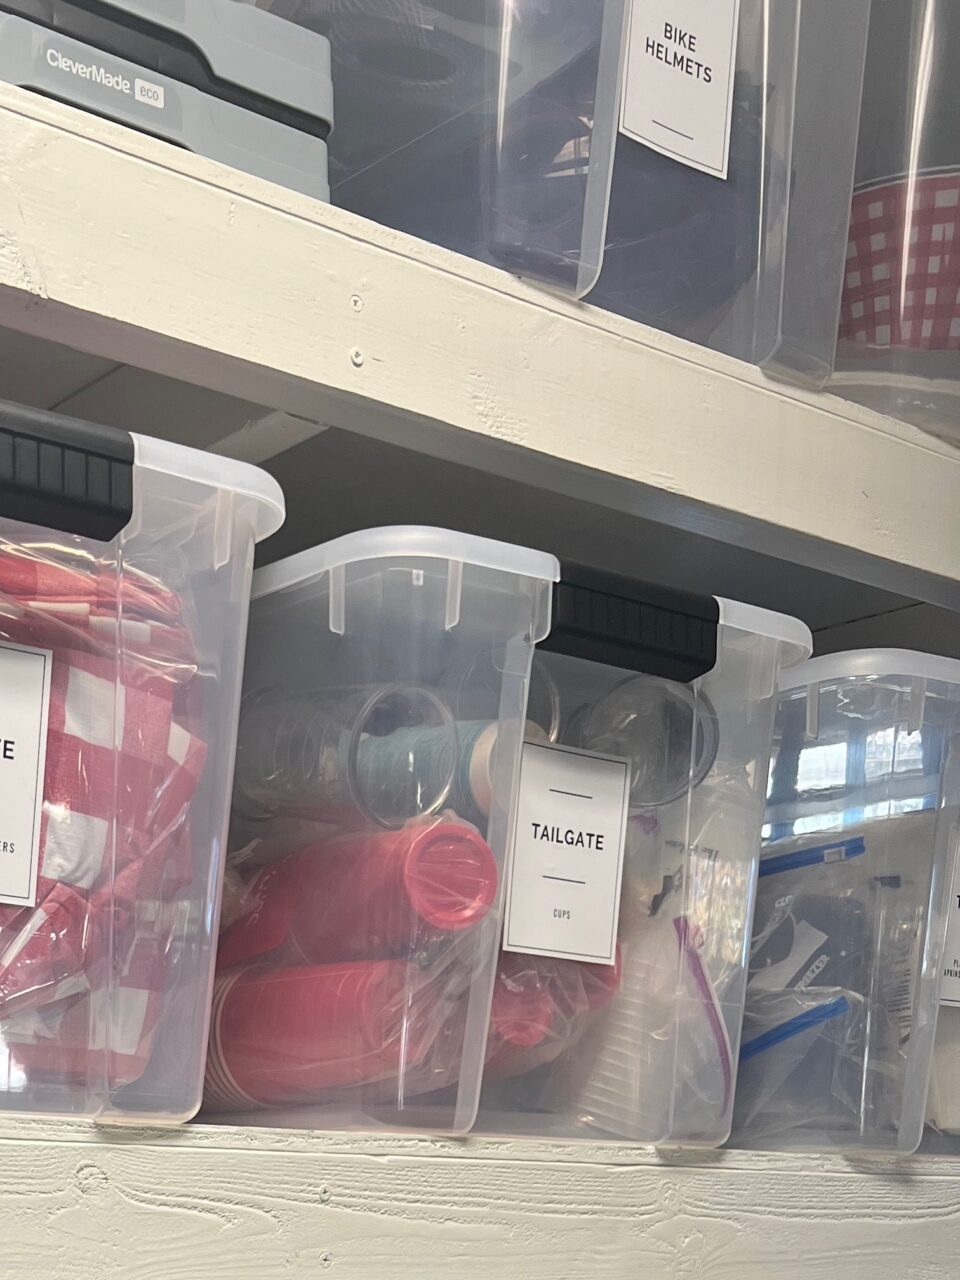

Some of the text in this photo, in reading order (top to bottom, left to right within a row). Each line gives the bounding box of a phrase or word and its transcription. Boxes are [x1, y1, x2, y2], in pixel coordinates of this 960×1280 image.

[664, 22, 696, 52] BIKE
[46, 49, 159, 101] CleverMade eco
[645, 37, 712, 83] HELMETS
[532, 823, 605, 851] TAILGATE
[553, 908, 572, 920] CUPS
